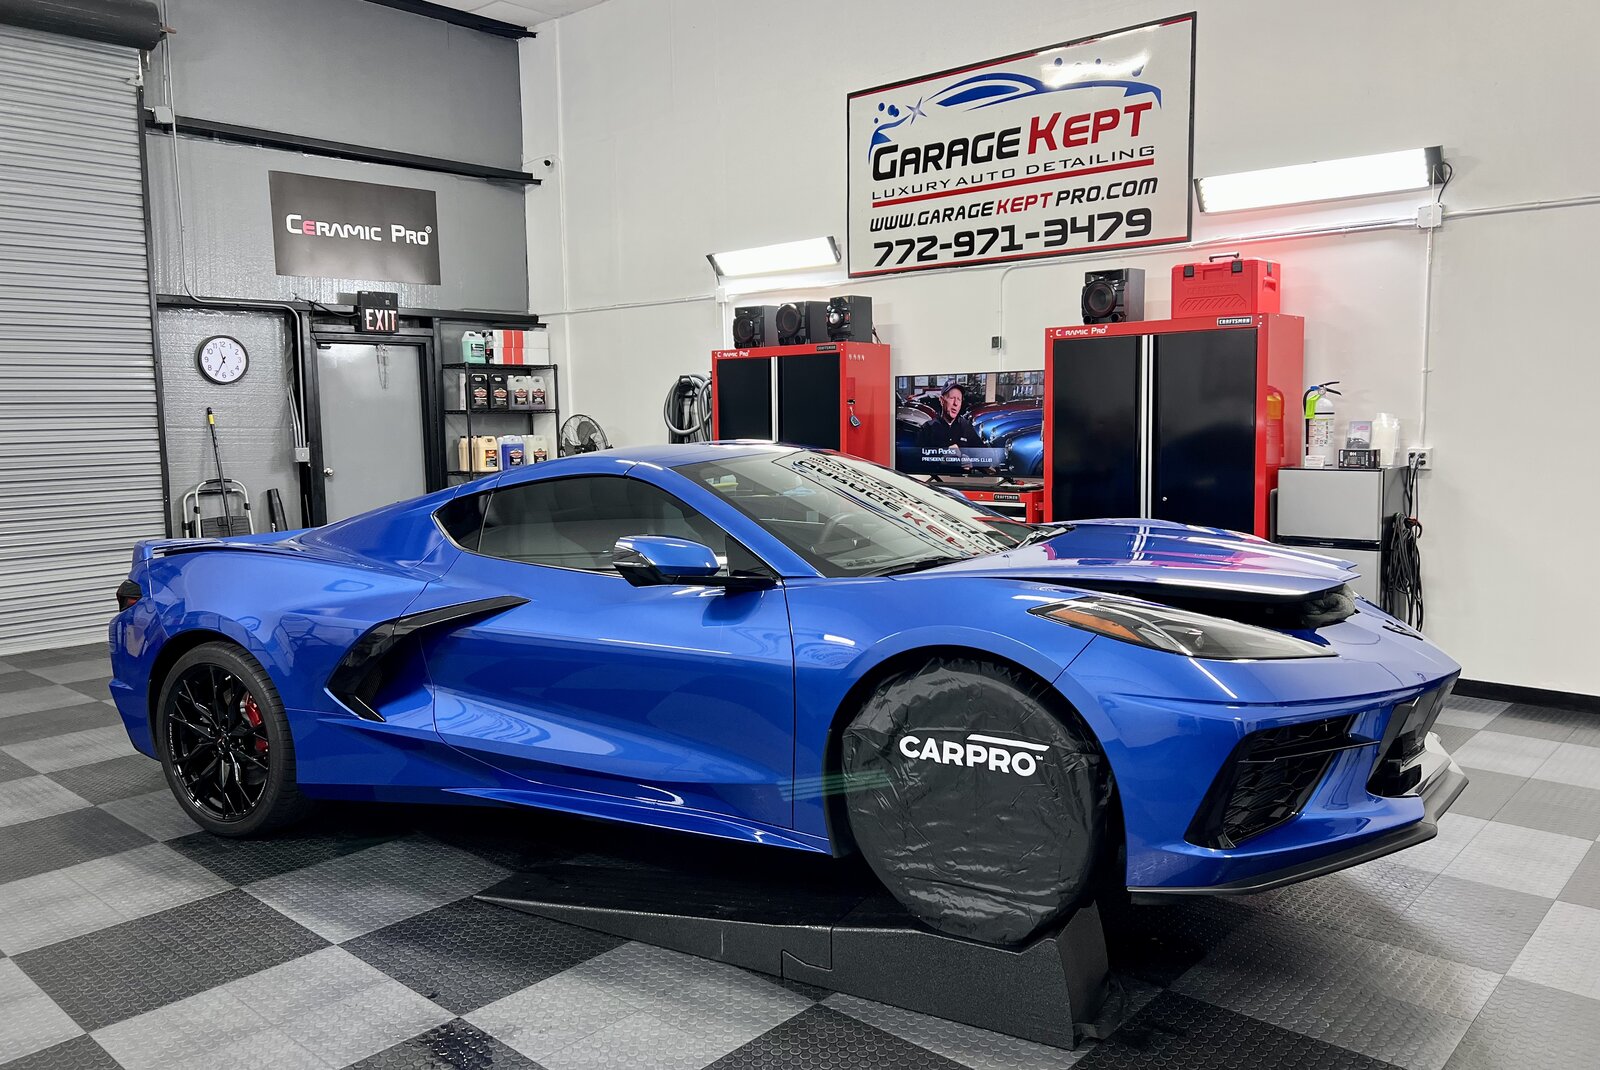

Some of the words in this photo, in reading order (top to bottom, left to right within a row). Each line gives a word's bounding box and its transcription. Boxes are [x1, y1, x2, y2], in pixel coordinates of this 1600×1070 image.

[872, 127, 1022, 182] GARAGE
[1027, 101, 1153, 155] KEPT
[872, 179, 951, 200] LUXURY
[956, 168, 1015, 187] AUTO
[1026, 145, 1155, 175] DETAILING
[286, 214, 382, 242] CERAMIC
[873, 207, 1152, 267] 772-971-3479
[366, 309, 397, 331] EXIT
[1056, 329, 1089, 337] CRAMIC
[921, 447, 938, 456] Lynn
[938, 447, 957, 455] Parks
